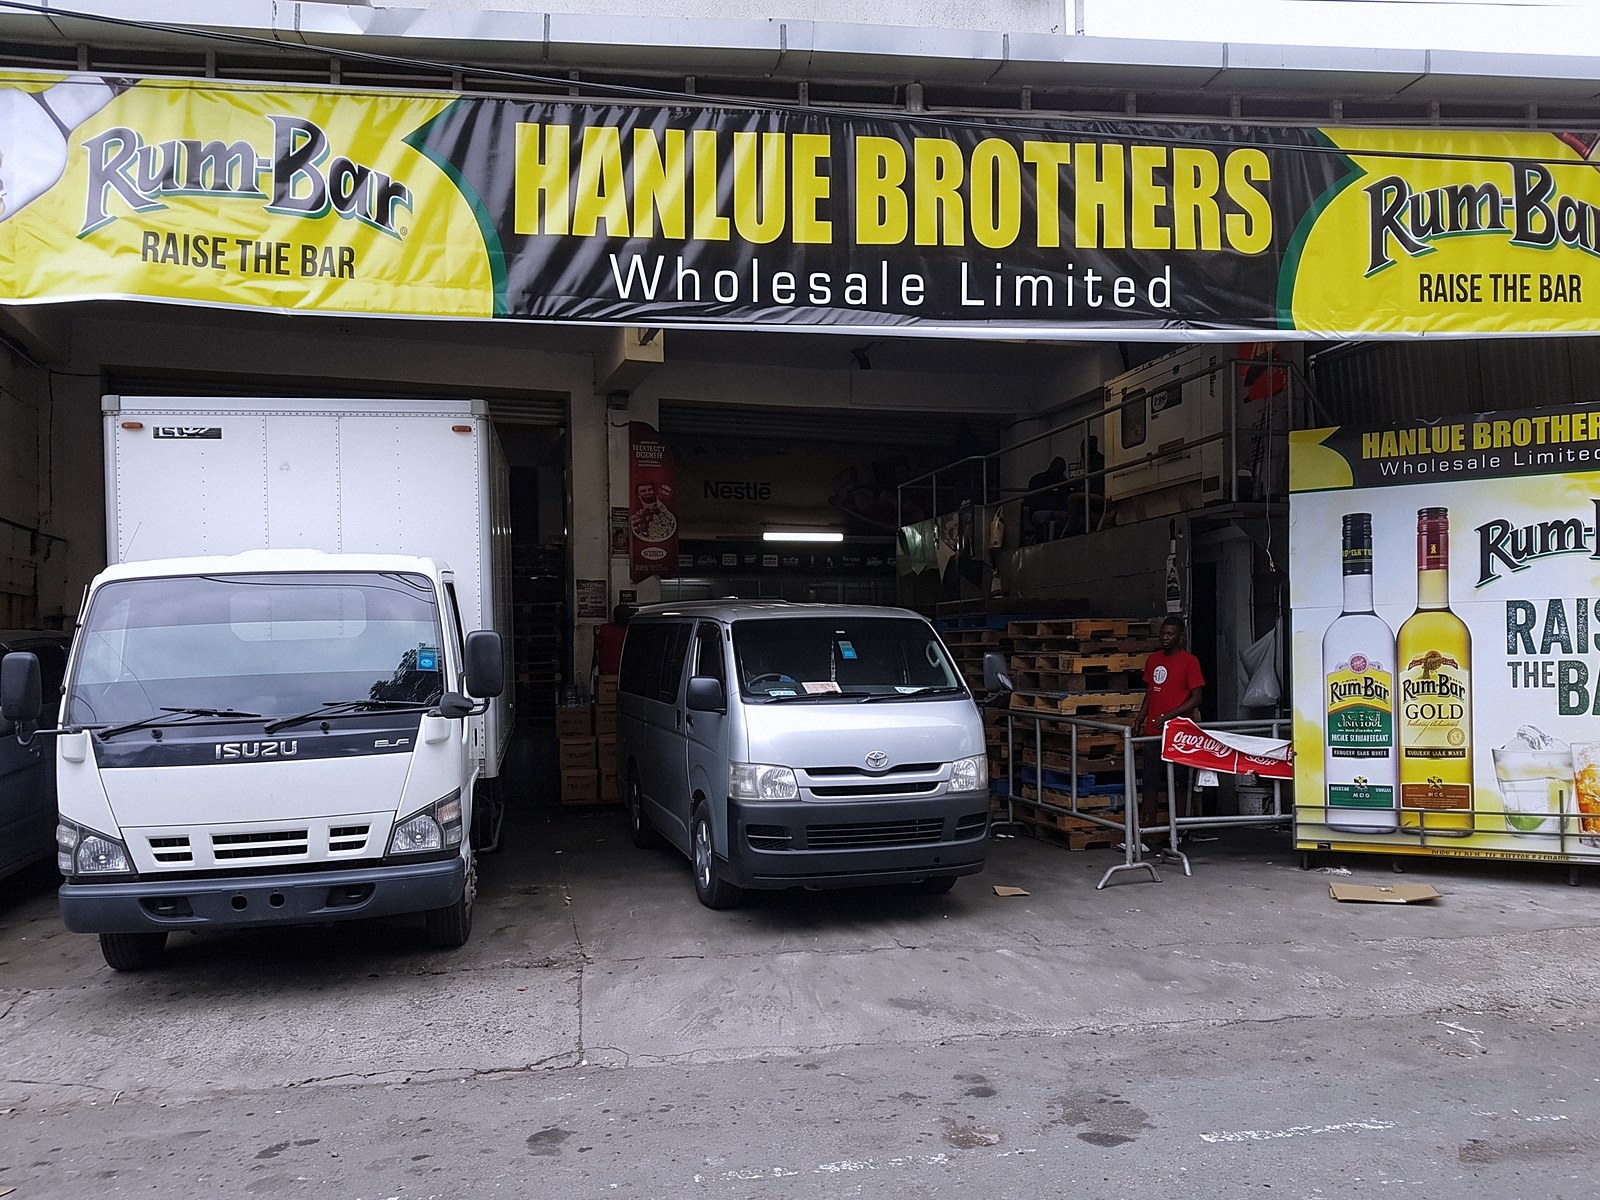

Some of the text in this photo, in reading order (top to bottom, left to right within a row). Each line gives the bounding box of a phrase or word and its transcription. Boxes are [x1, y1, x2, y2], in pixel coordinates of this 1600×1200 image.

[77, 114, 414, 241] Rum-Bar
[514, 121, 1273, 255] HANLUE BROTHERS
[141, 231, 356, 280] RAISE THE BAR
[608, 253, 1171, 309] Wholesale Limited
[1419, 273, 1583, 303] RAISE THE BAR
[1362, 424, 1466, 460] HANLUE
[1379, 454, 1501, 476] Wholesale
[703, 479, 772, 501] Nestlé
[1474, 498, 1600, 589] Rum-
[1506, 598, 1600, 656] RAI
[1507, 660, 1555, 688] THE
[1405, 702, 1465, 720] GOLD
[214, 740, 298, 760] ISUZU
